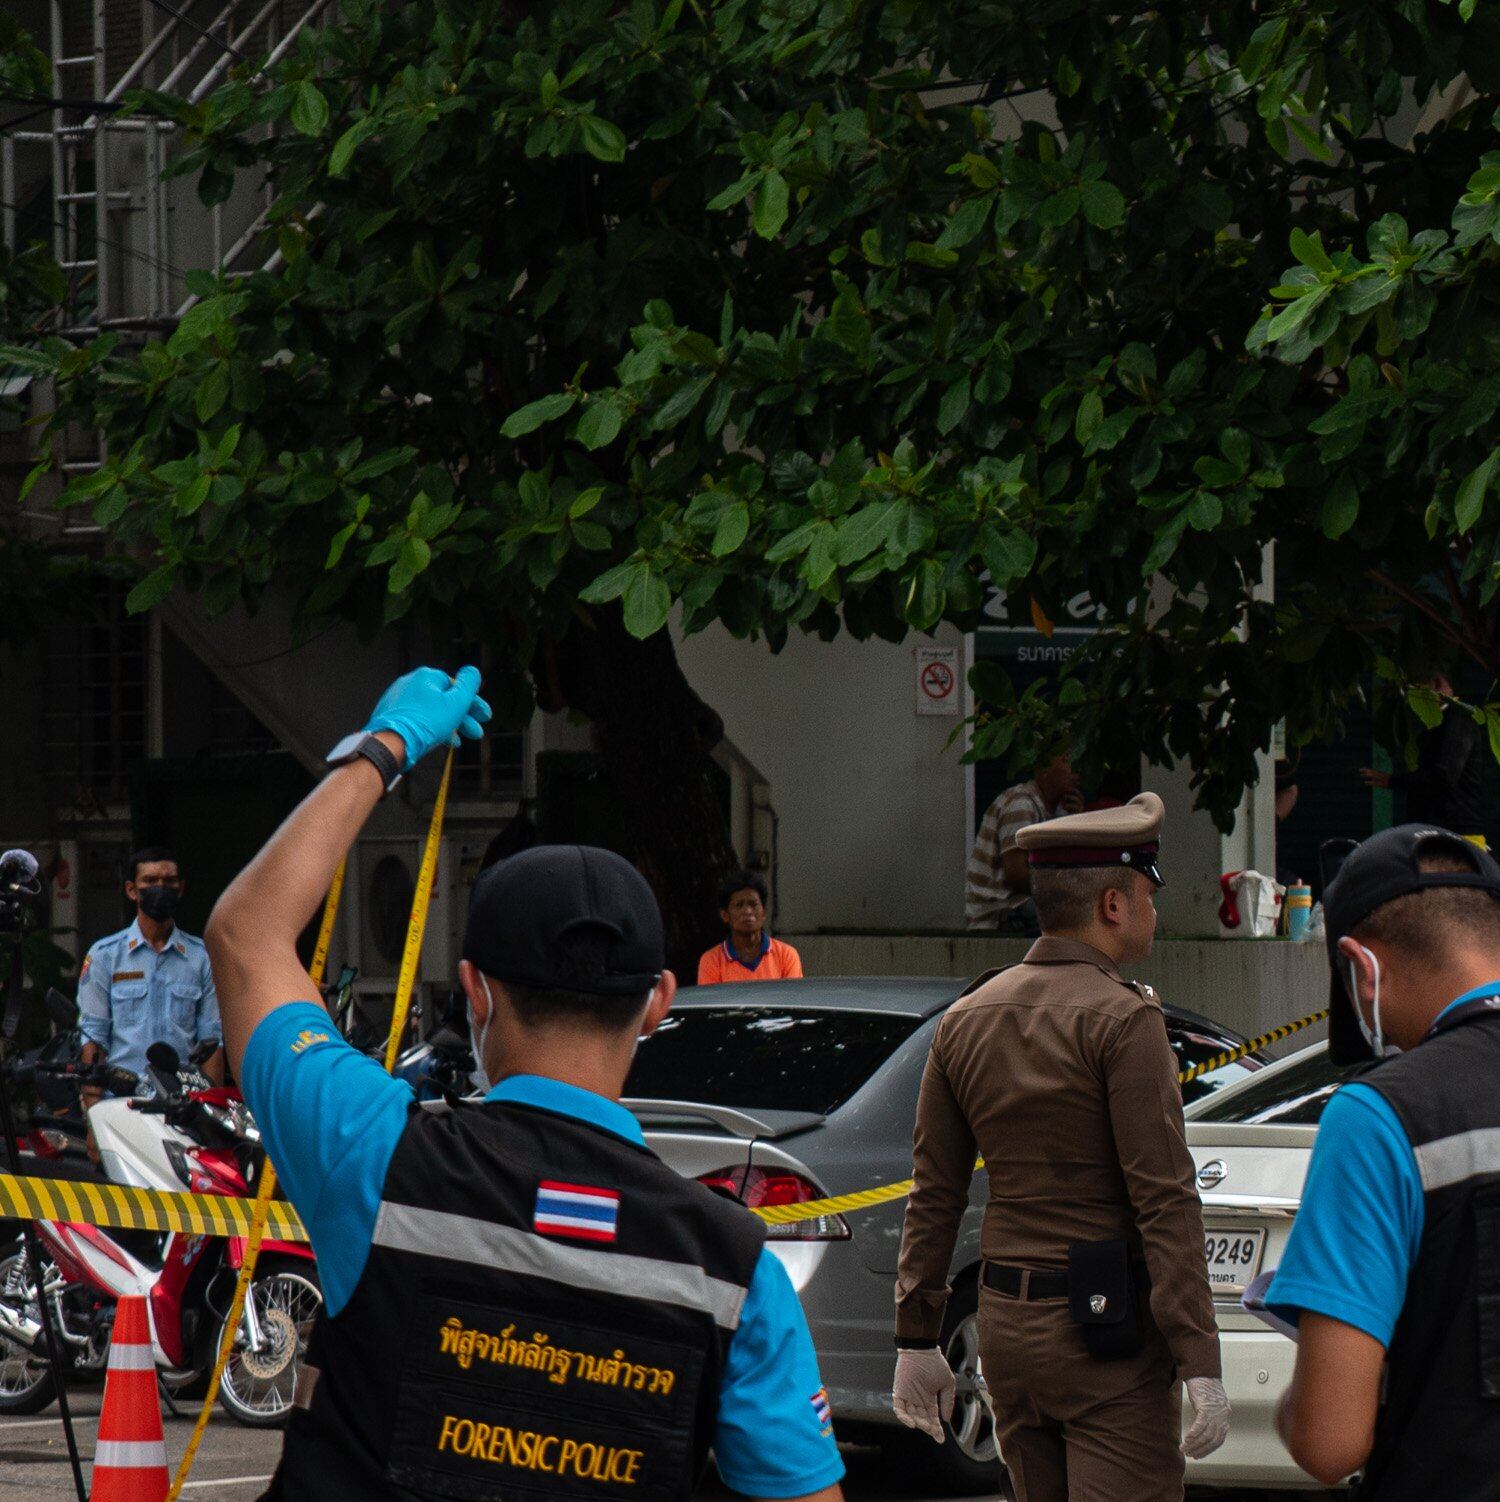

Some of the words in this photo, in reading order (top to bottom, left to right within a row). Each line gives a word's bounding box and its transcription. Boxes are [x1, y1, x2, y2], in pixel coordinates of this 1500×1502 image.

[1205, 1237, 1255, 1265] 9249
[439, 1316, 676, 1396] พิสูจน์หลักฐานตำรวจ
[438, 1415, 559, 1472] FORENSIC
[557, 1438, 645, 1484] POLICE
